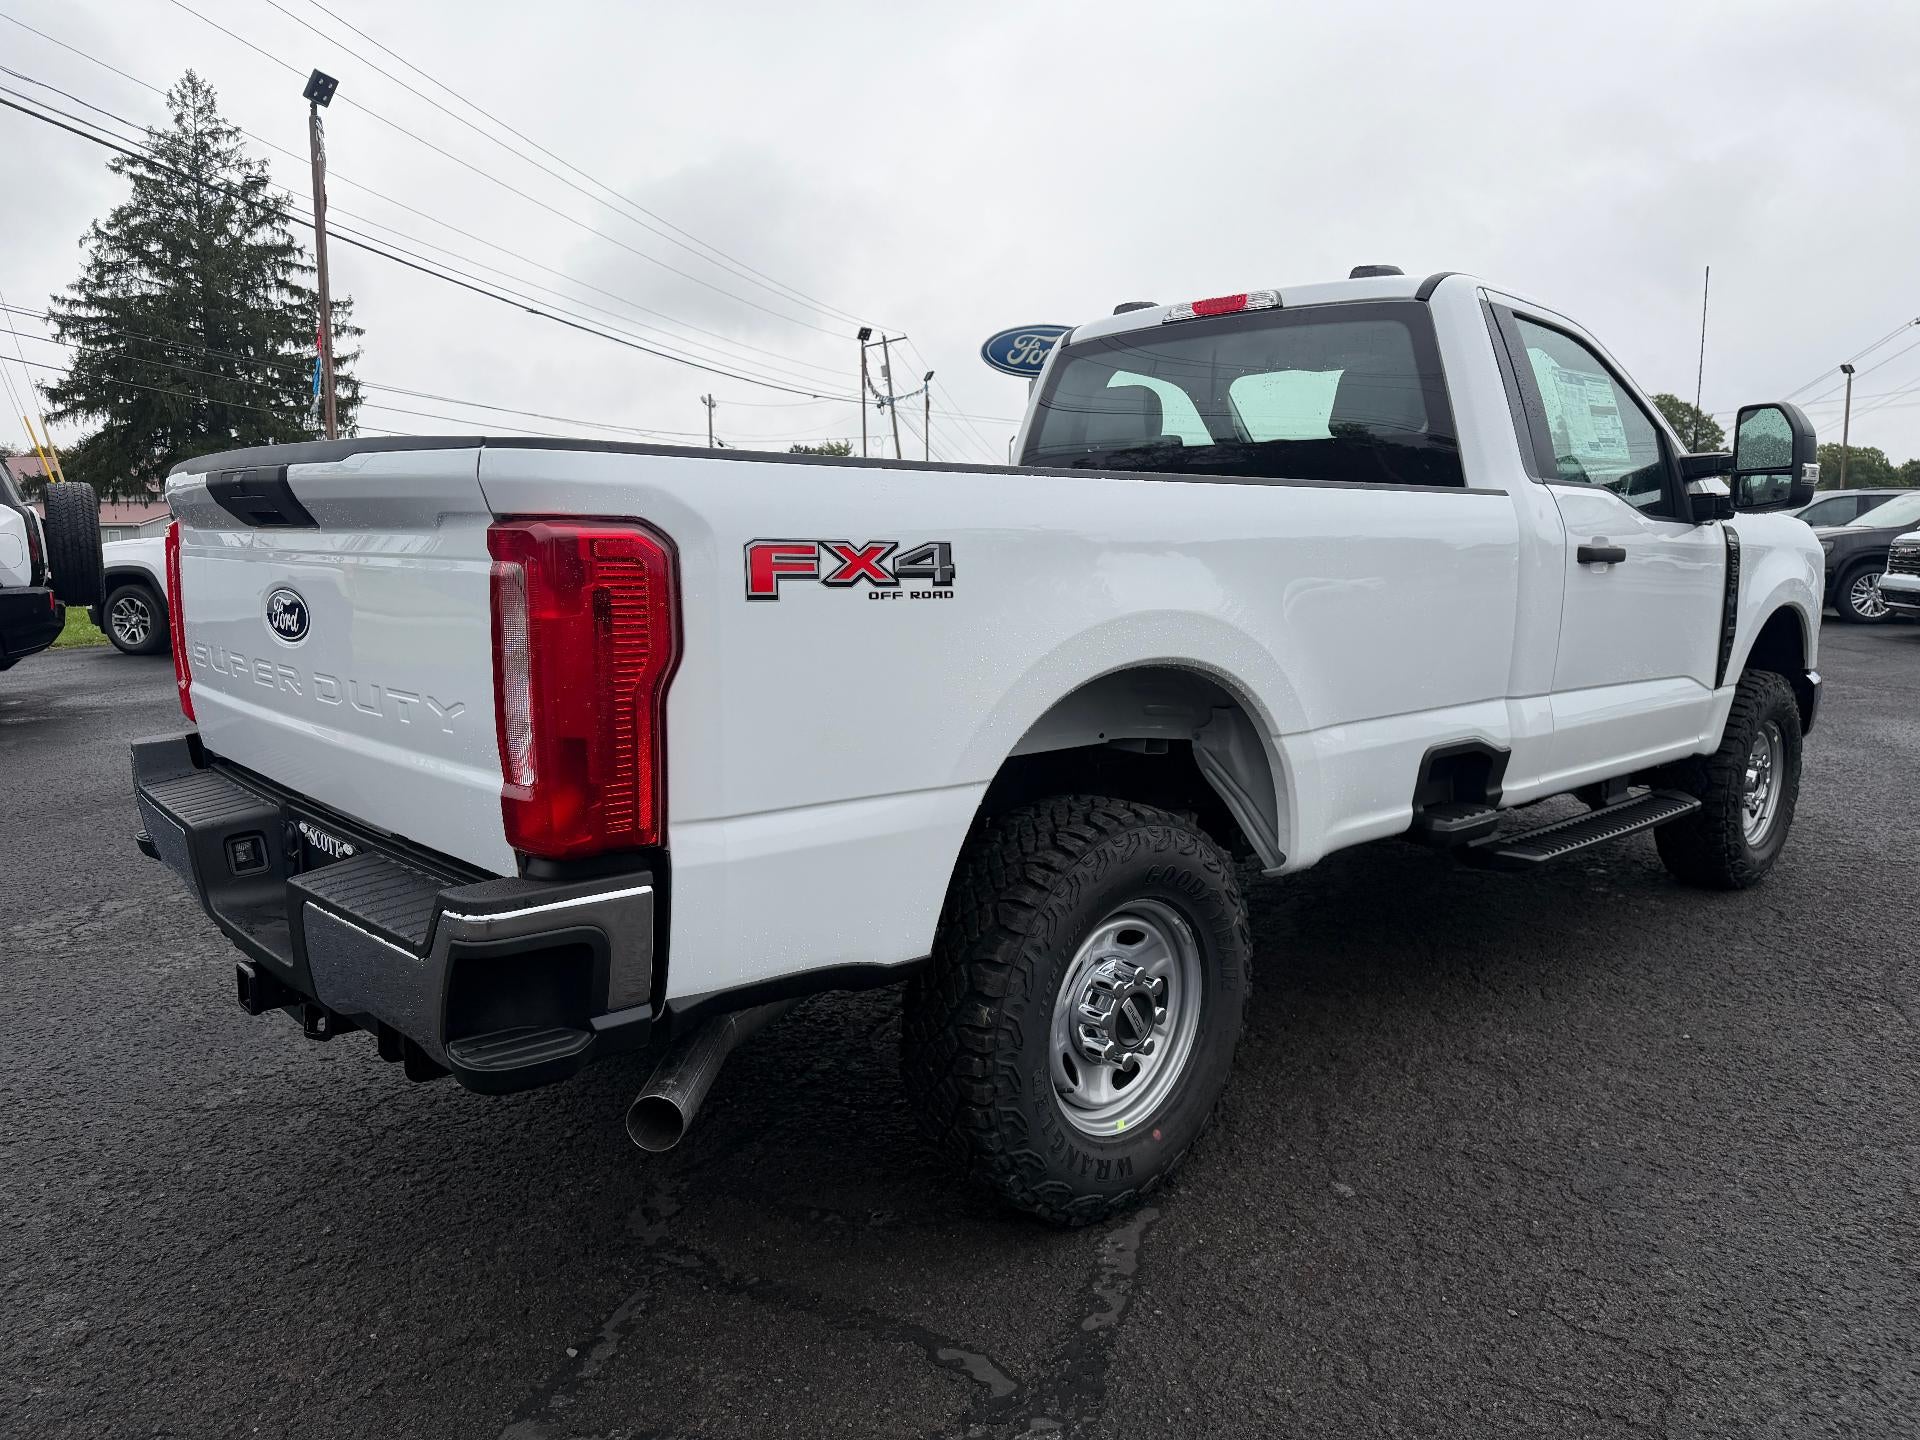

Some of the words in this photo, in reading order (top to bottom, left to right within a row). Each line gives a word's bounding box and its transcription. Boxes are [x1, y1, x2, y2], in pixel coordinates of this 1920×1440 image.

[1006, 334, 1060, 365] For
[744, 538, 955, 601] FX4
[868, 591, 904, 600] OFF
[909, 590, 954, 600] ROAD
[272, 596, 299, 632] Ford
[192, 641, 302, 696] SUPER
[313, 671, 465, 734] DUTY
[309, 828, 342, 858] SCOTT
